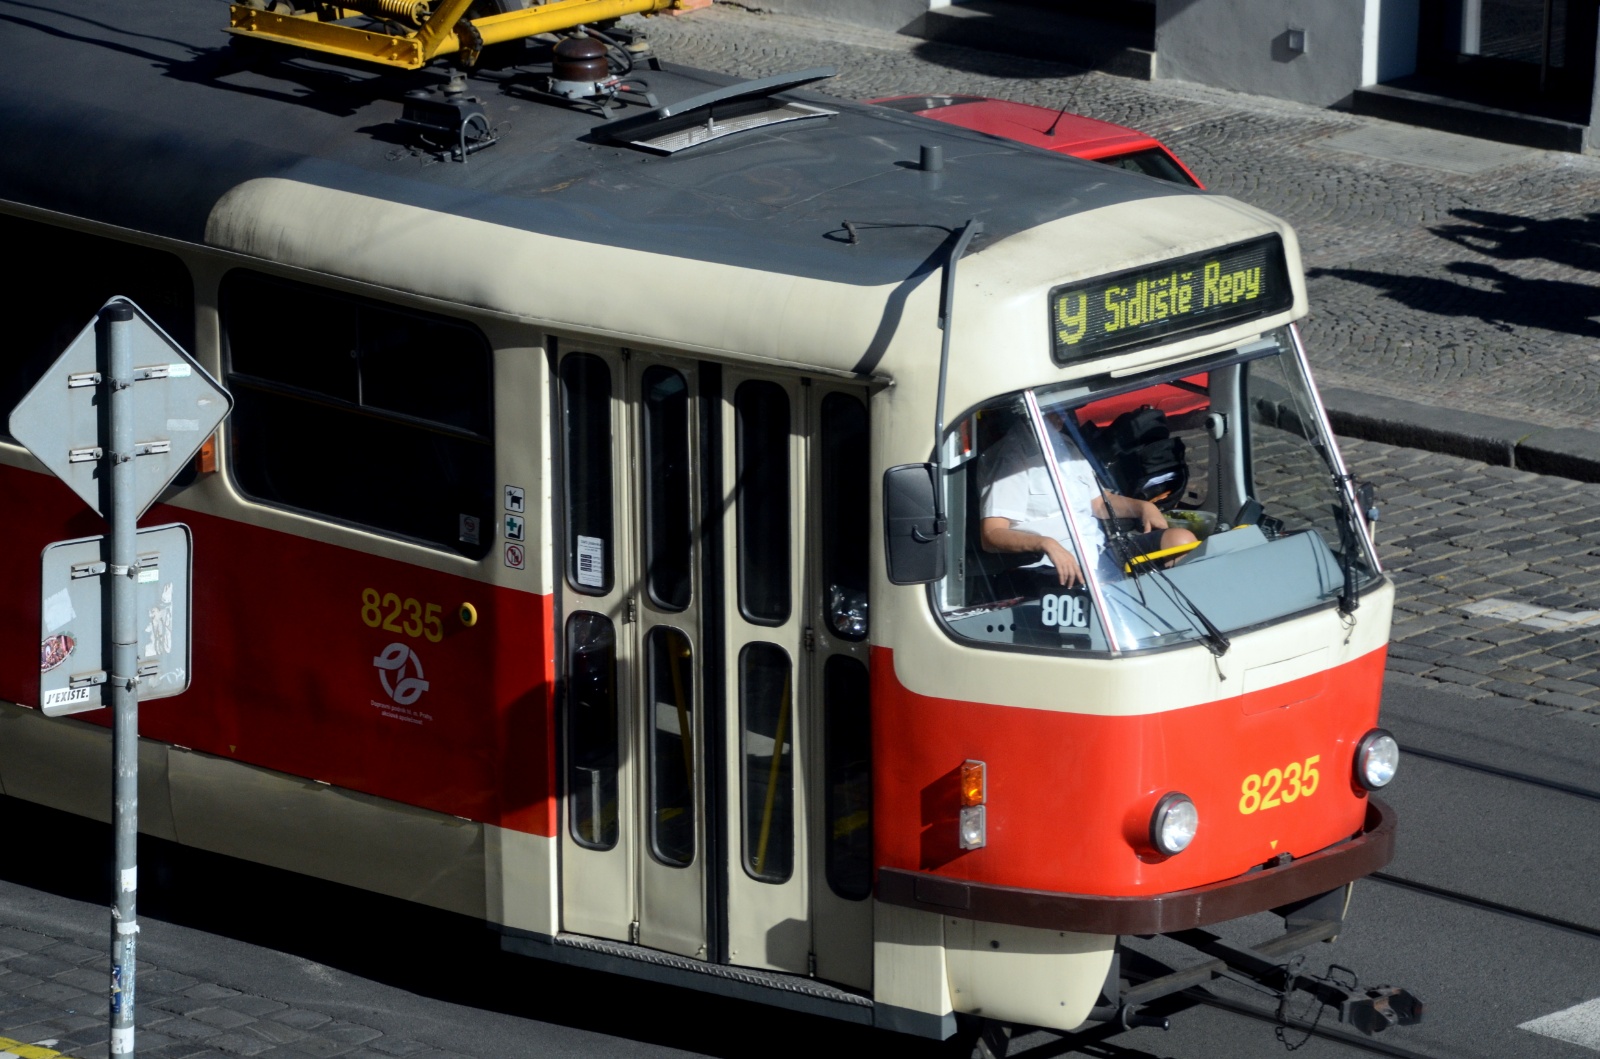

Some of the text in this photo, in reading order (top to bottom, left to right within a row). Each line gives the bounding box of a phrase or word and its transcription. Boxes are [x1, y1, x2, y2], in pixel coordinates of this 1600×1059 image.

[1059, 291, 1087, 345] 9
[361, 588, 443, 643] 8235
[1238, 754, 1320, 815] 8235
